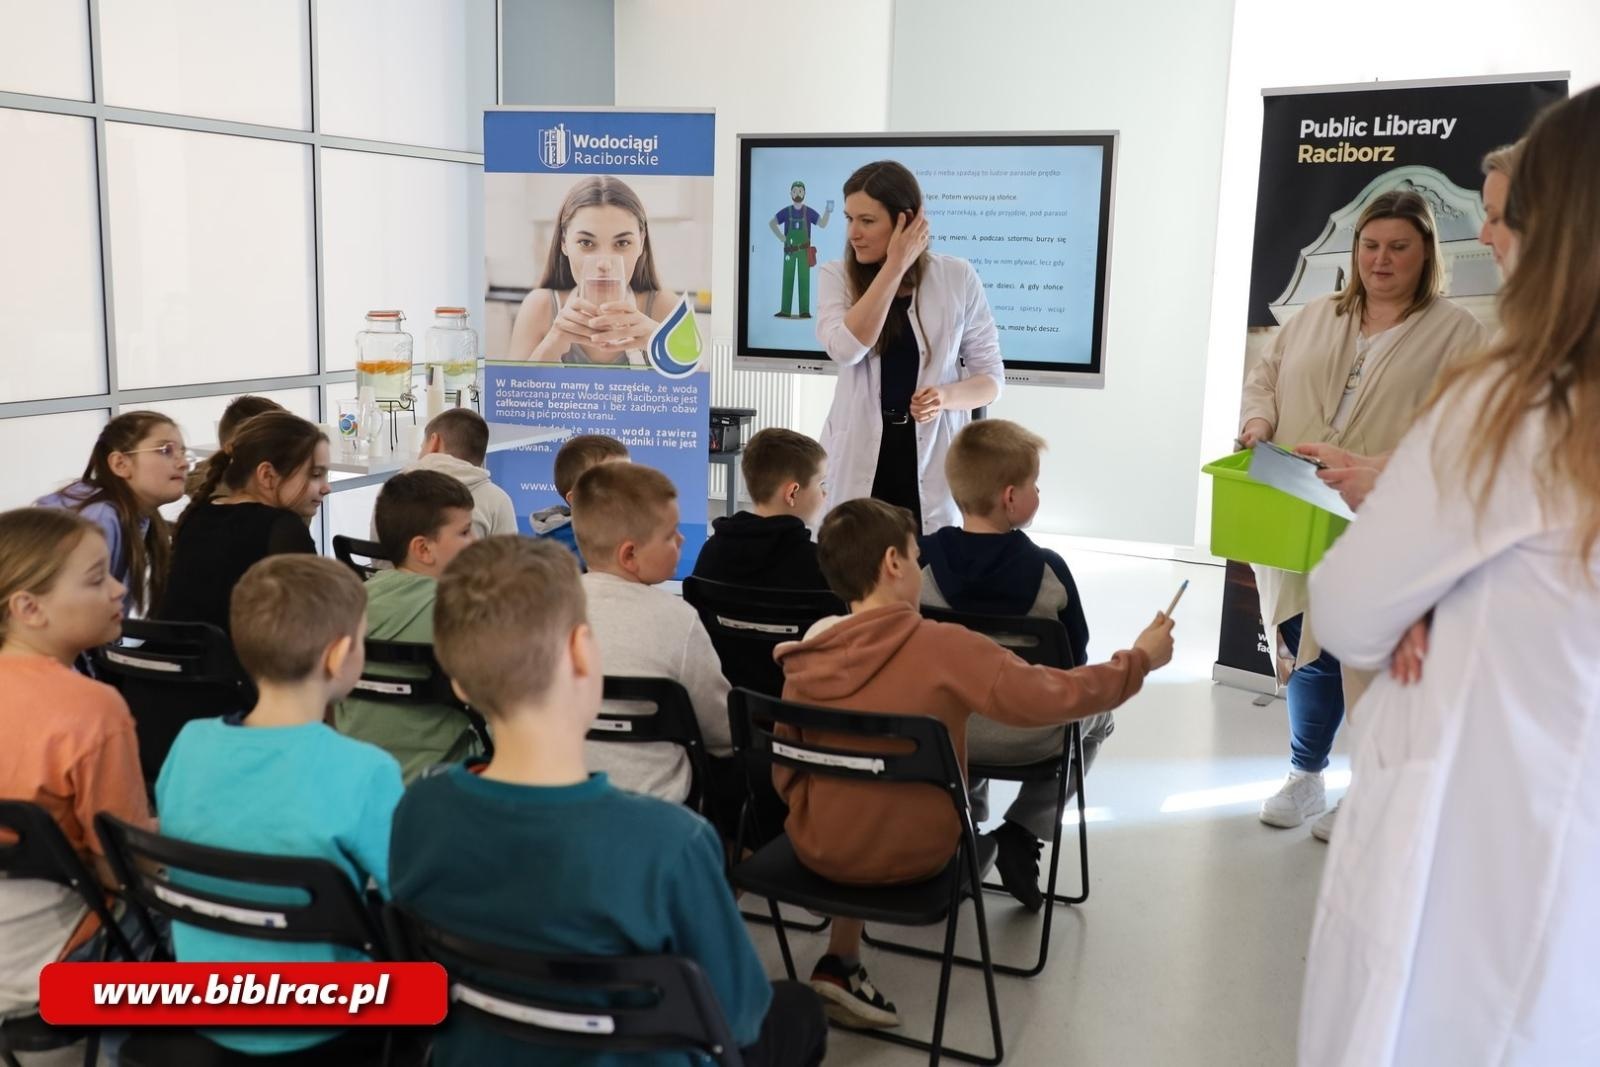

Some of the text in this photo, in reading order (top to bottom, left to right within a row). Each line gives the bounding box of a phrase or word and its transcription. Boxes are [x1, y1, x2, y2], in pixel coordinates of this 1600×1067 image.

[1300, 114, 1457, 139] Public Library
[573, 134, 658, 152] Wodociągi
[574, 151, 659, 165] Raciborskie
[1298, 142, 1395, 163] Raciborz
[496, 379, 506, 387] W
[511, 379, 556, 389] Raciborzu
[561, 382, 590, 391] mamy
[609, 382, 653, 394] szczęście,
[658, 384, 668, 392] że
[673, 385, 698, 393] woda
[496, 388, 549, 398] dostarczana
[578, 391, 625, 402] Wodociągi
[628, 393, 679, 403] Raciborskie
[681, 394, 697, 404] jest
[496, 397, 697, 414] całkowicie bezpieczna i bez żadnych obaw
[496, 408, 525, 417] można
[527, 409, 535, 420] ją
[537, 408, 550, 419] pić
[552, 411, 581, 420] prosto
[588, 411, 616, 420] kranu.
[588, 426, 616, 436] nasza
[622, 427, 650, 436] woda
[656, 428, 697, 438] zawiera
[657, 437, 660, 446] i
[663, 438, 677, 447] nie
[680, 439, 697, 449] jest
